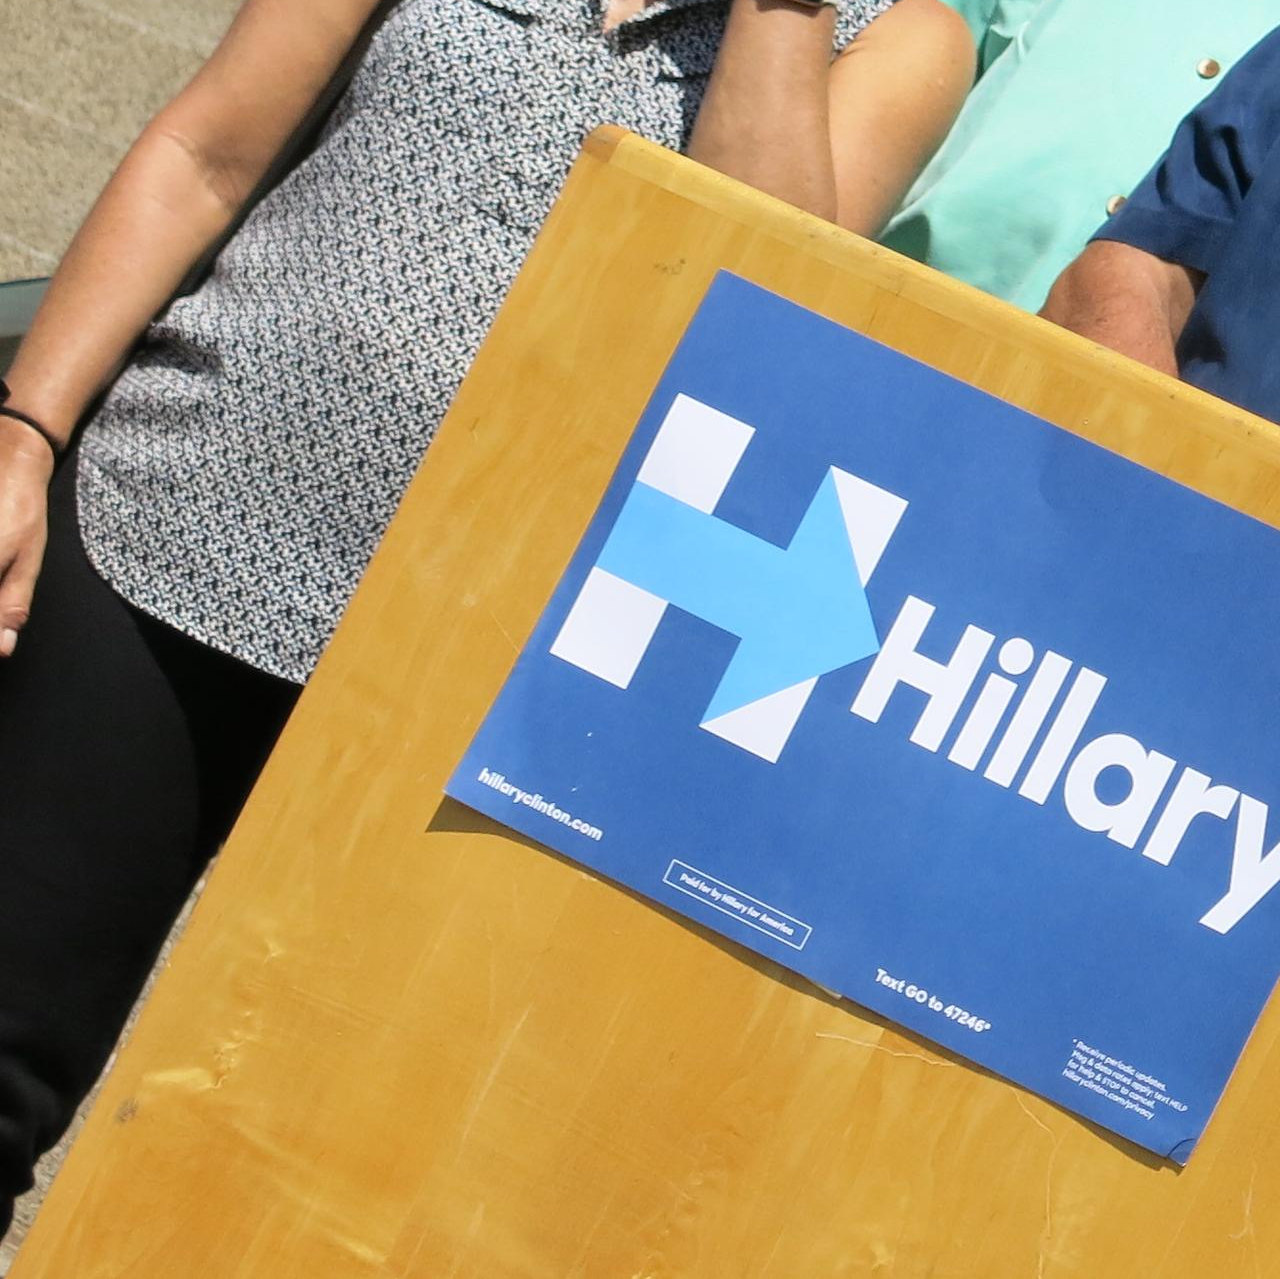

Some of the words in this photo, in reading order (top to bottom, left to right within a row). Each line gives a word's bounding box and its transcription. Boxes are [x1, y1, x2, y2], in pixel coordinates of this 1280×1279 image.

[477, 767, 604, 841] hillaryclinton.com
[679, 872, 701, 890] Paid
[697, 881, 711, 894] for
[710, 887, 722, 901] by
[721, 893, 748, 914] Hillary
[747, 906, 761, 919] for
[759, 913, 795, 936] America
[875, 968, 906, 994] Text
[905, 984, 928, 1003] GO
[928, 995, 944, 1012] to
[1094, 1062, 1113, 1076] data
[1111, 1071, 1133, 1085] rates
[1104, 1056, 1135, 1076] periodic
